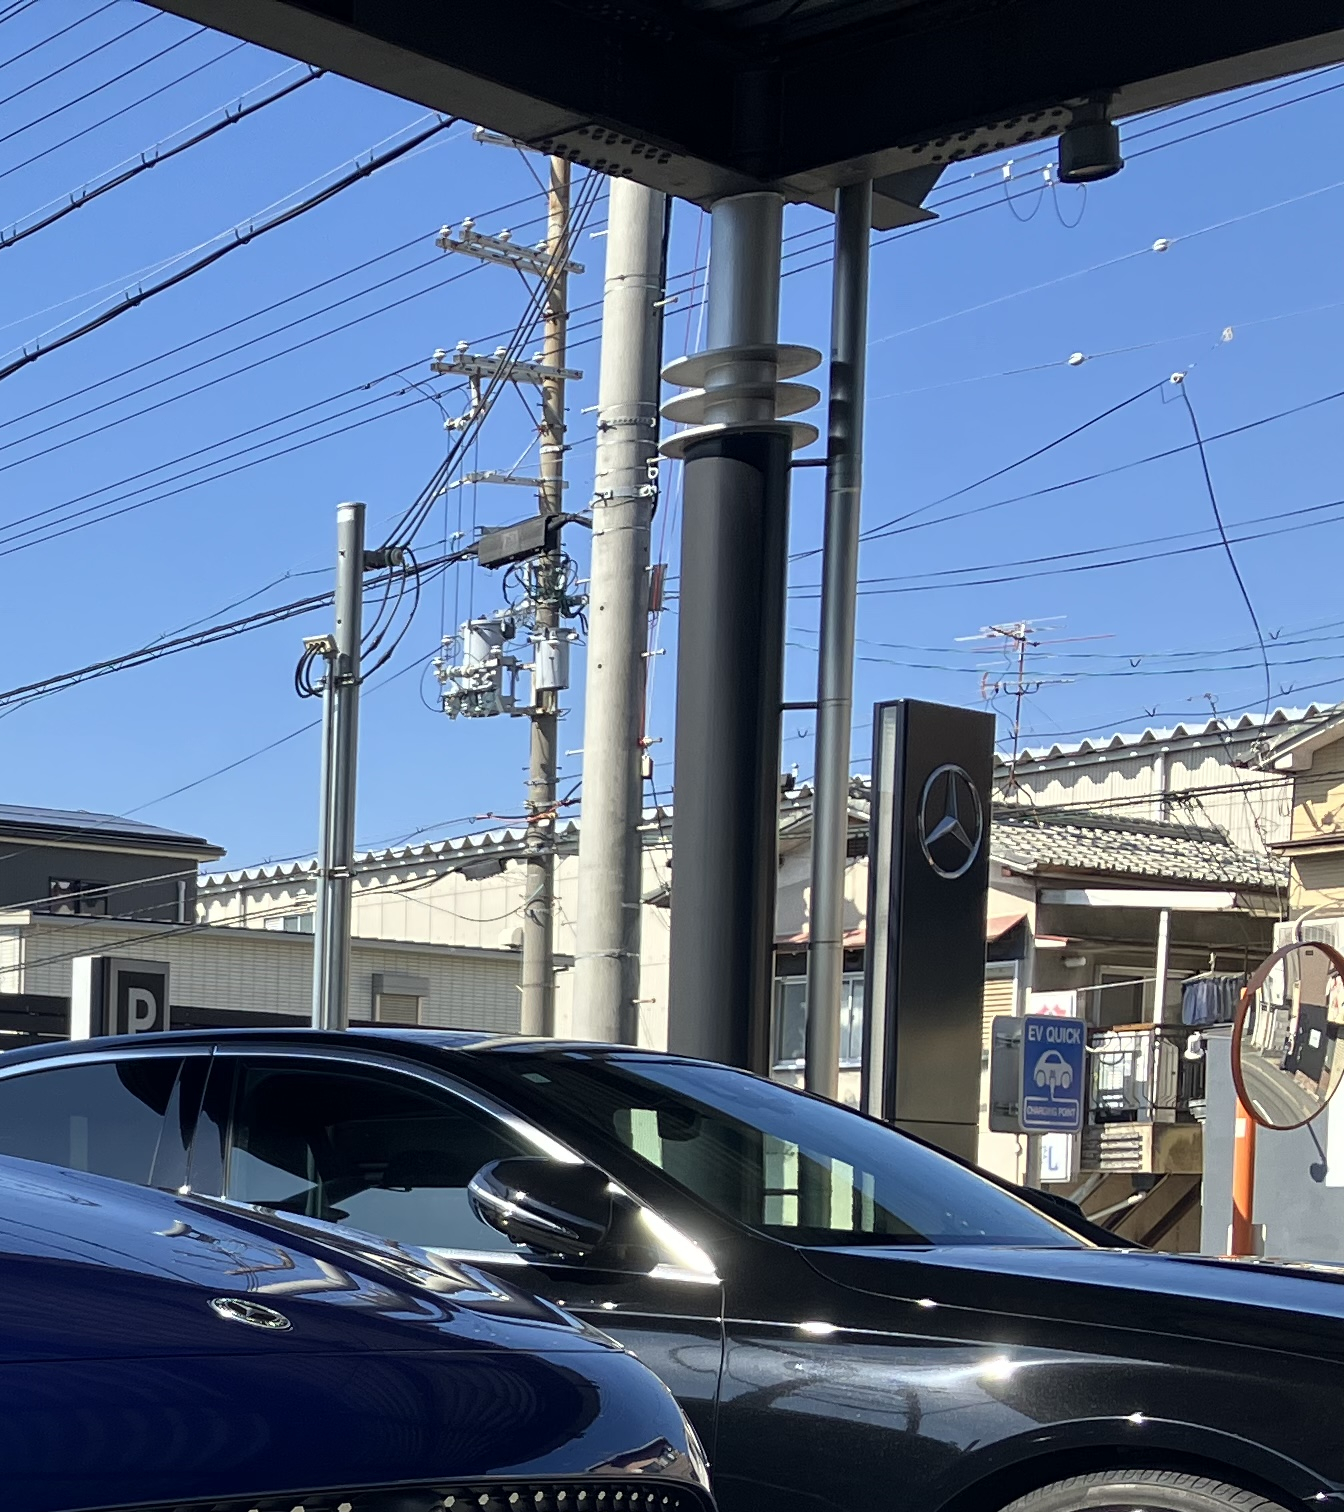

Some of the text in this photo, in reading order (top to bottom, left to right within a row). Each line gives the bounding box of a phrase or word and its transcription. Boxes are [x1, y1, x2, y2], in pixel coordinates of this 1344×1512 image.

[128, 987, 157, 1034] P
[1028, 1025, 1081, 1044] EV QUICK
